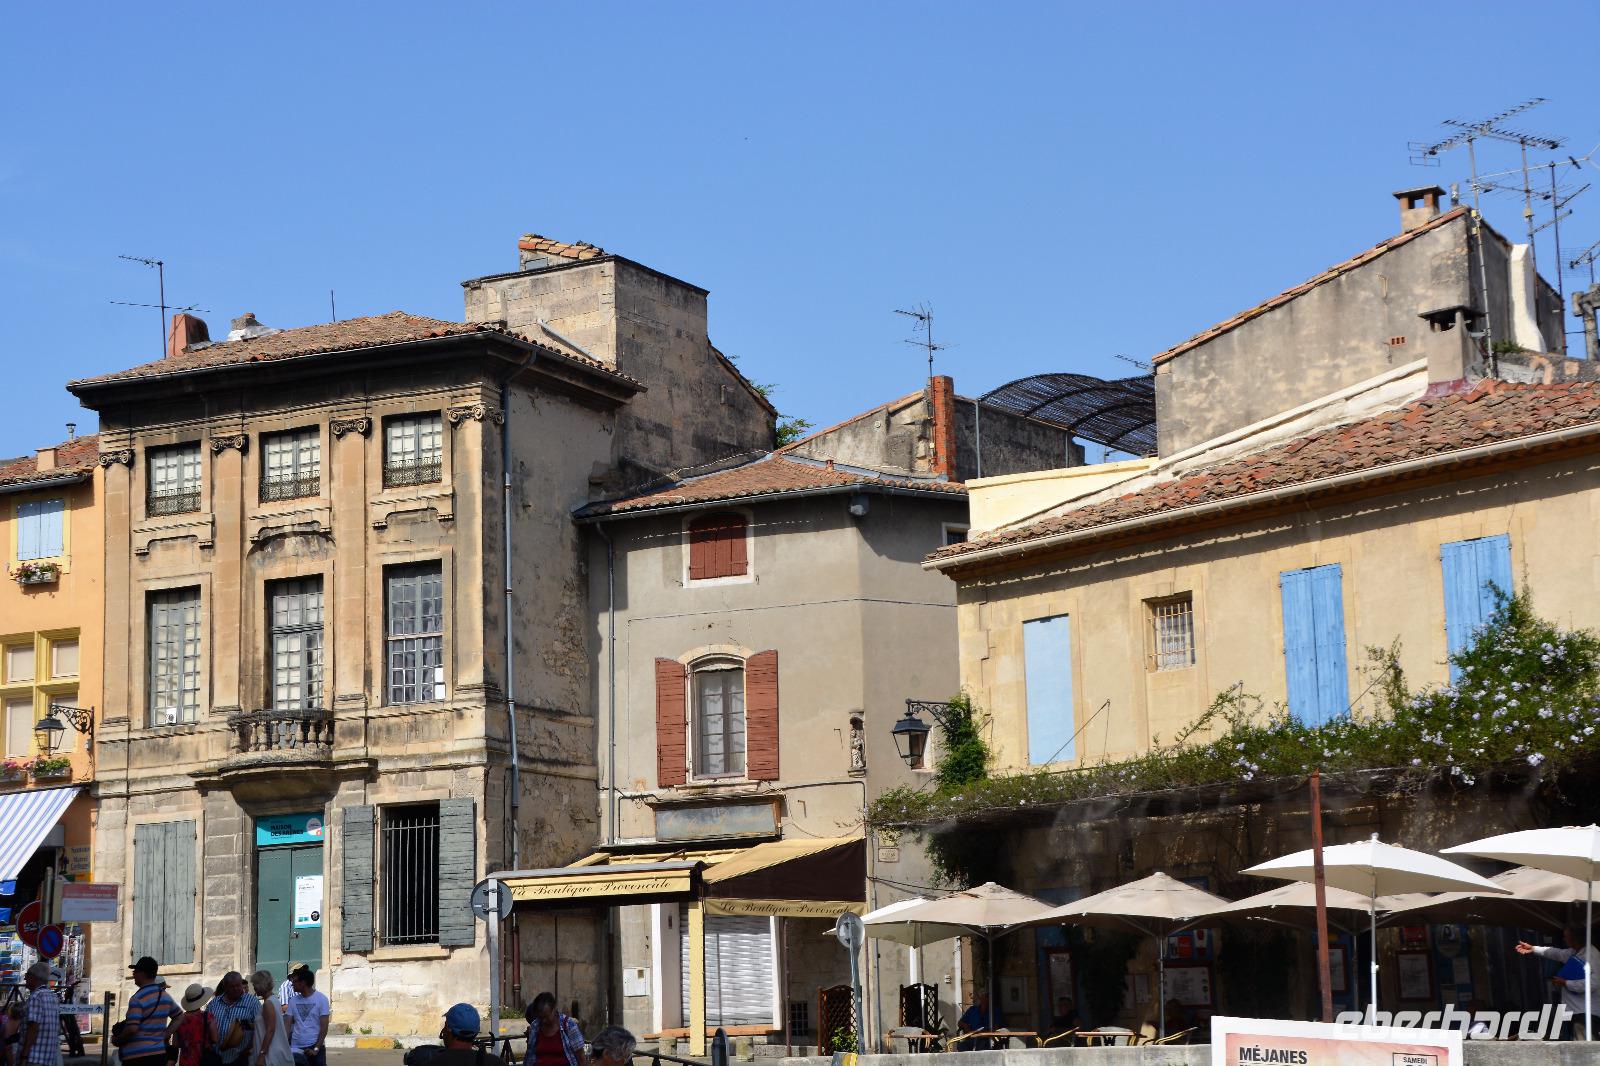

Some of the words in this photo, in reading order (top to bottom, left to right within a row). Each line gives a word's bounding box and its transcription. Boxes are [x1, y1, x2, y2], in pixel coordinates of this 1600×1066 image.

[533, 884, 593, 897] Boutique
[720, 902, 736, 911] La
[741, 902, 791, 916] Boutique
[1239, 1045, 1308, 1065] MÉJANES
[1402, 1056, 1428, 1065] SAMEDI
